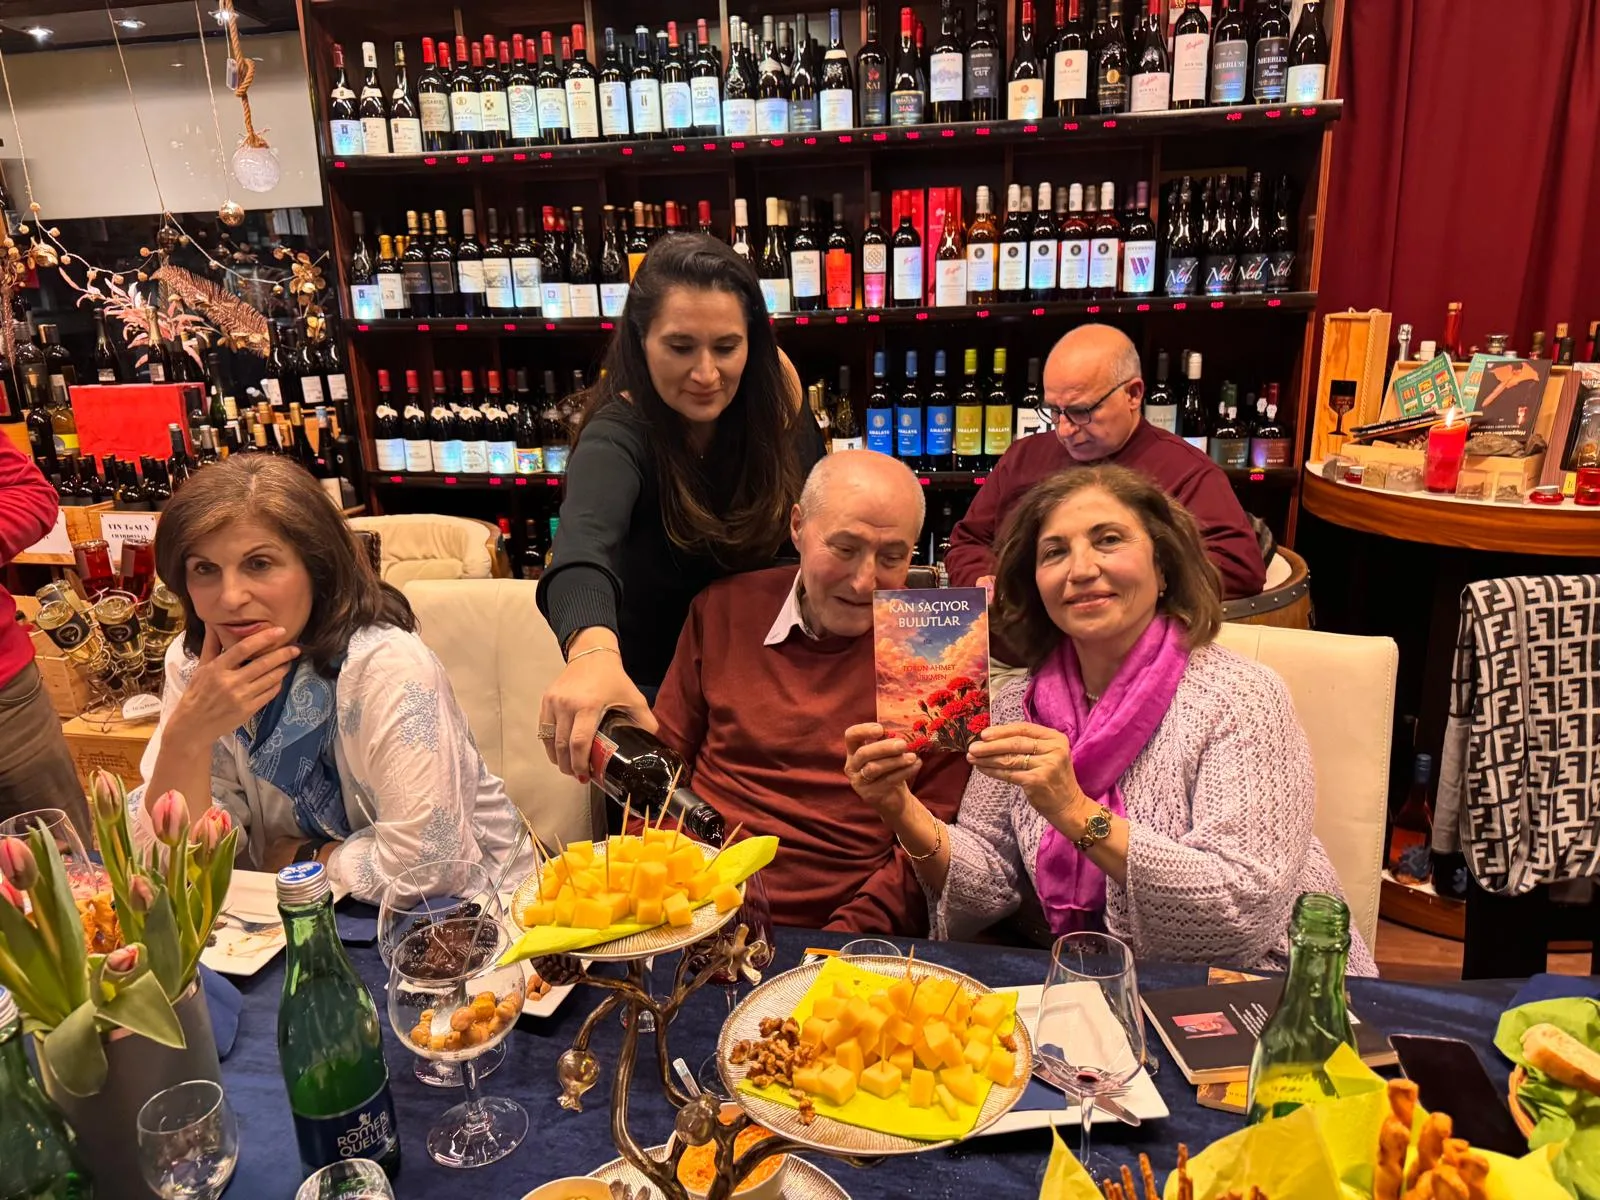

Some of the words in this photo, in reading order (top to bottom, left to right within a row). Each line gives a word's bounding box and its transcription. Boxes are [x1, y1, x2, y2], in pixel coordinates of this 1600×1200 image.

[888, 601, 915, 613] KAN
[918, 600, 970, 614] SAÇIYOR
[899, 615, 961, 628] BULUTLAR
[930, 663, 956, 671] AHMET
[340, 1121, 390, 1157] QUELLE
